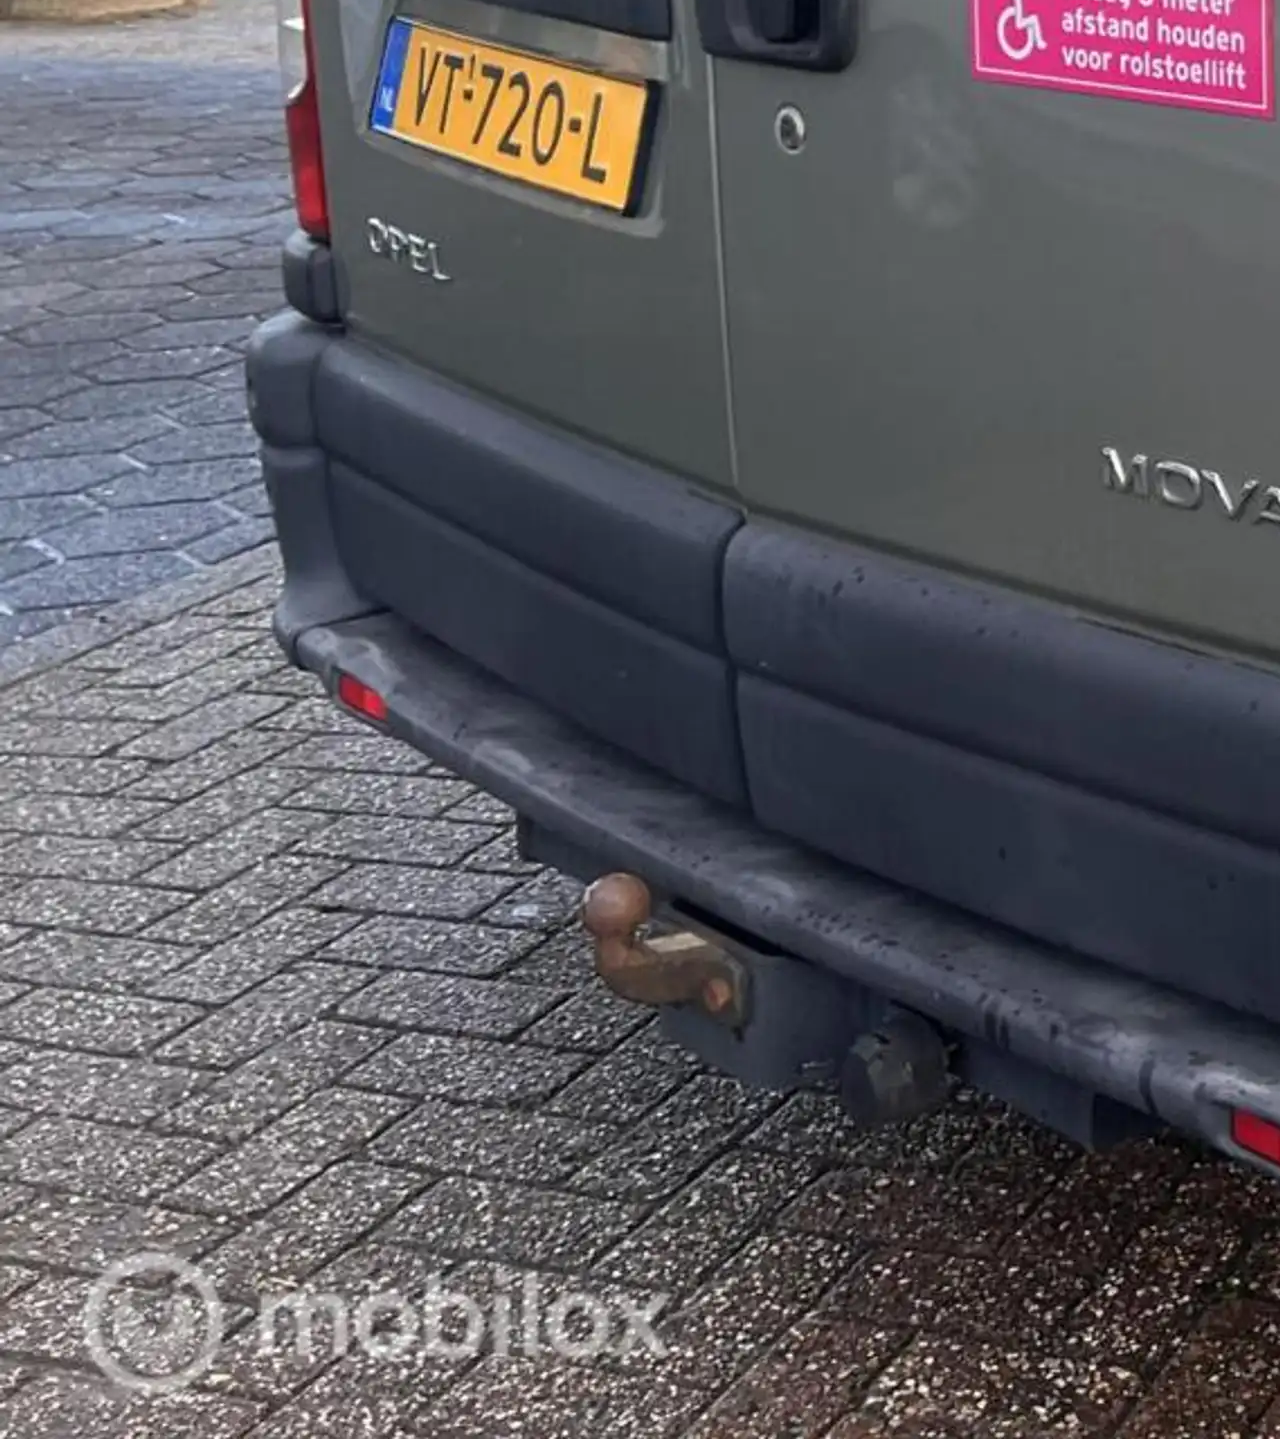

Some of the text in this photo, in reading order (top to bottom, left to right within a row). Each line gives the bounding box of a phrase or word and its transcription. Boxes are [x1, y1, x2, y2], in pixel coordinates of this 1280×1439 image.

[1061, 8, 1245, 54] afstand houden
[1061, 45, 1247, 90] voor rolstoellift
[367, 217, 451, 280] OPEL
